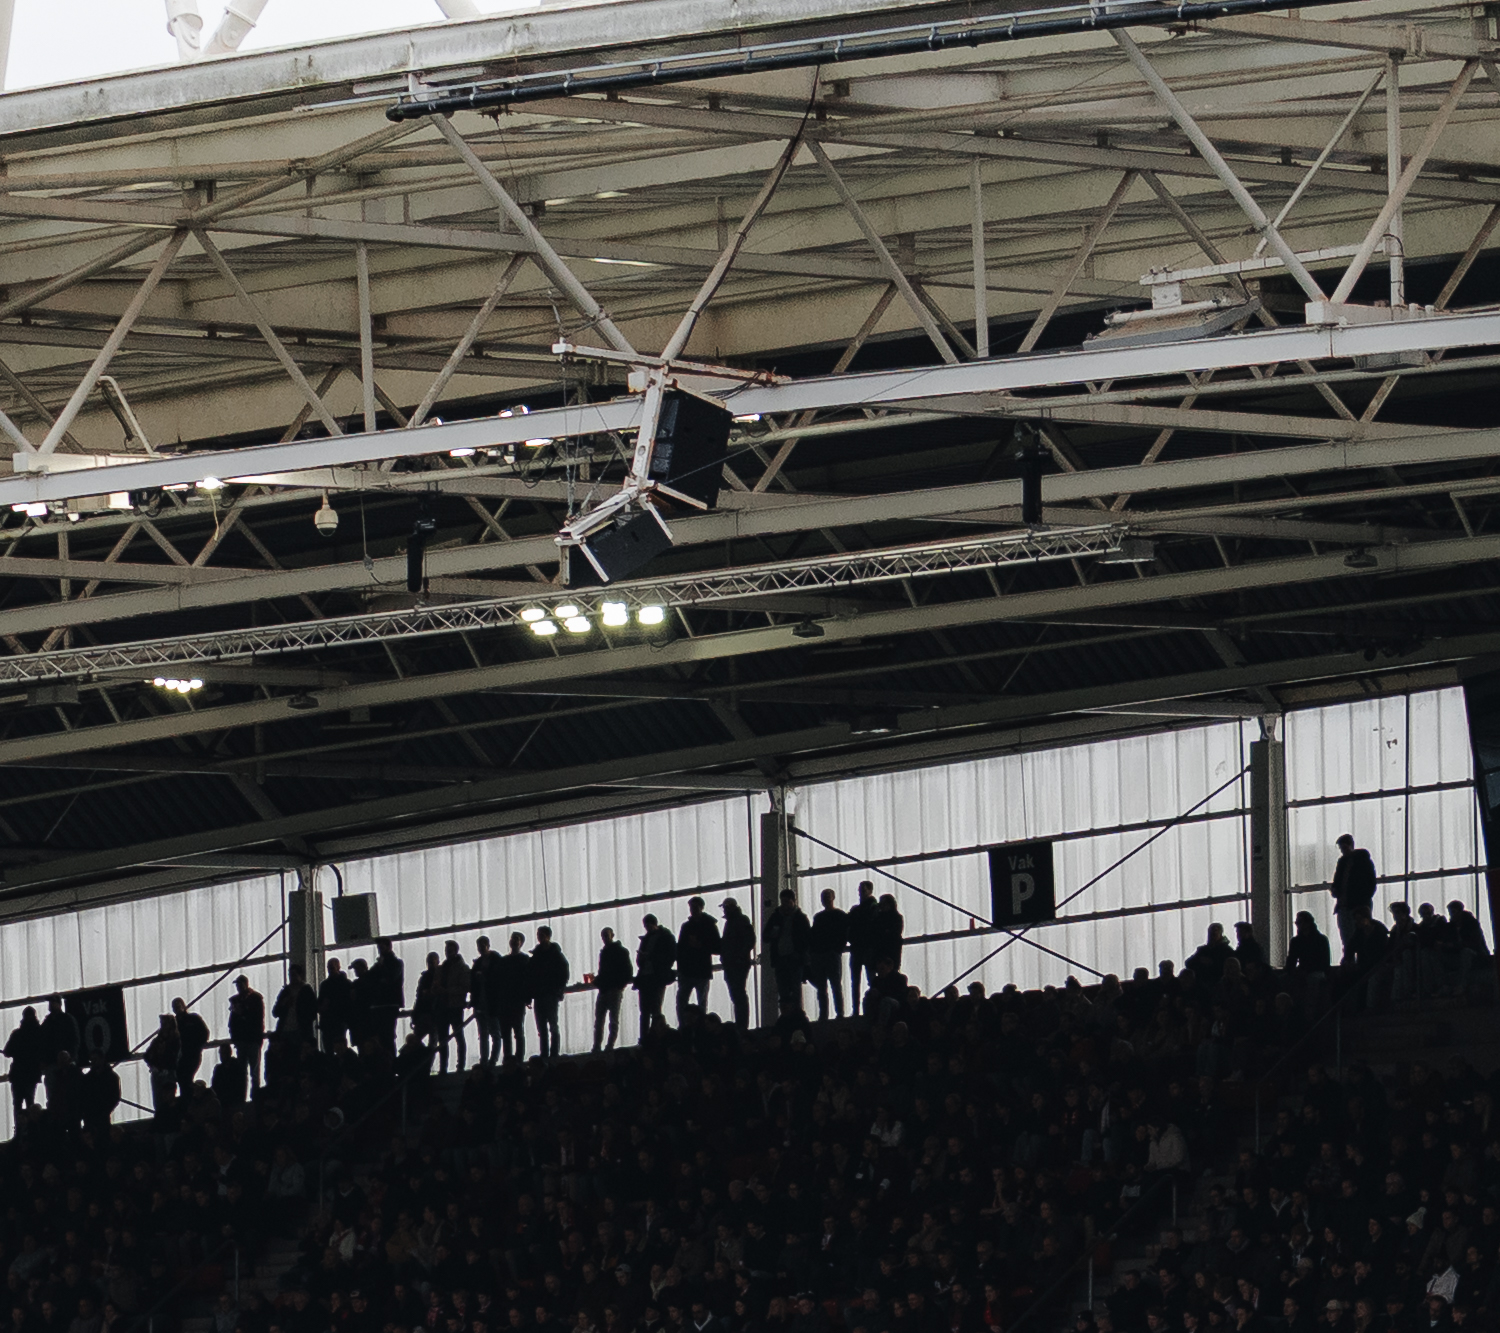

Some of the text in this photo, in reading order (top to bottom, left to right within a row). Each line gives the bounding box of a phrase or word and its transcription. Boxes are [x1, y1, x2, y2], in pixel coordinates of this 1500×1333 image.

[1008, 853, 1035, 871] Vak
[1011, 872, 1036, 915] P
[82, 998, 108, 1015] Vak
